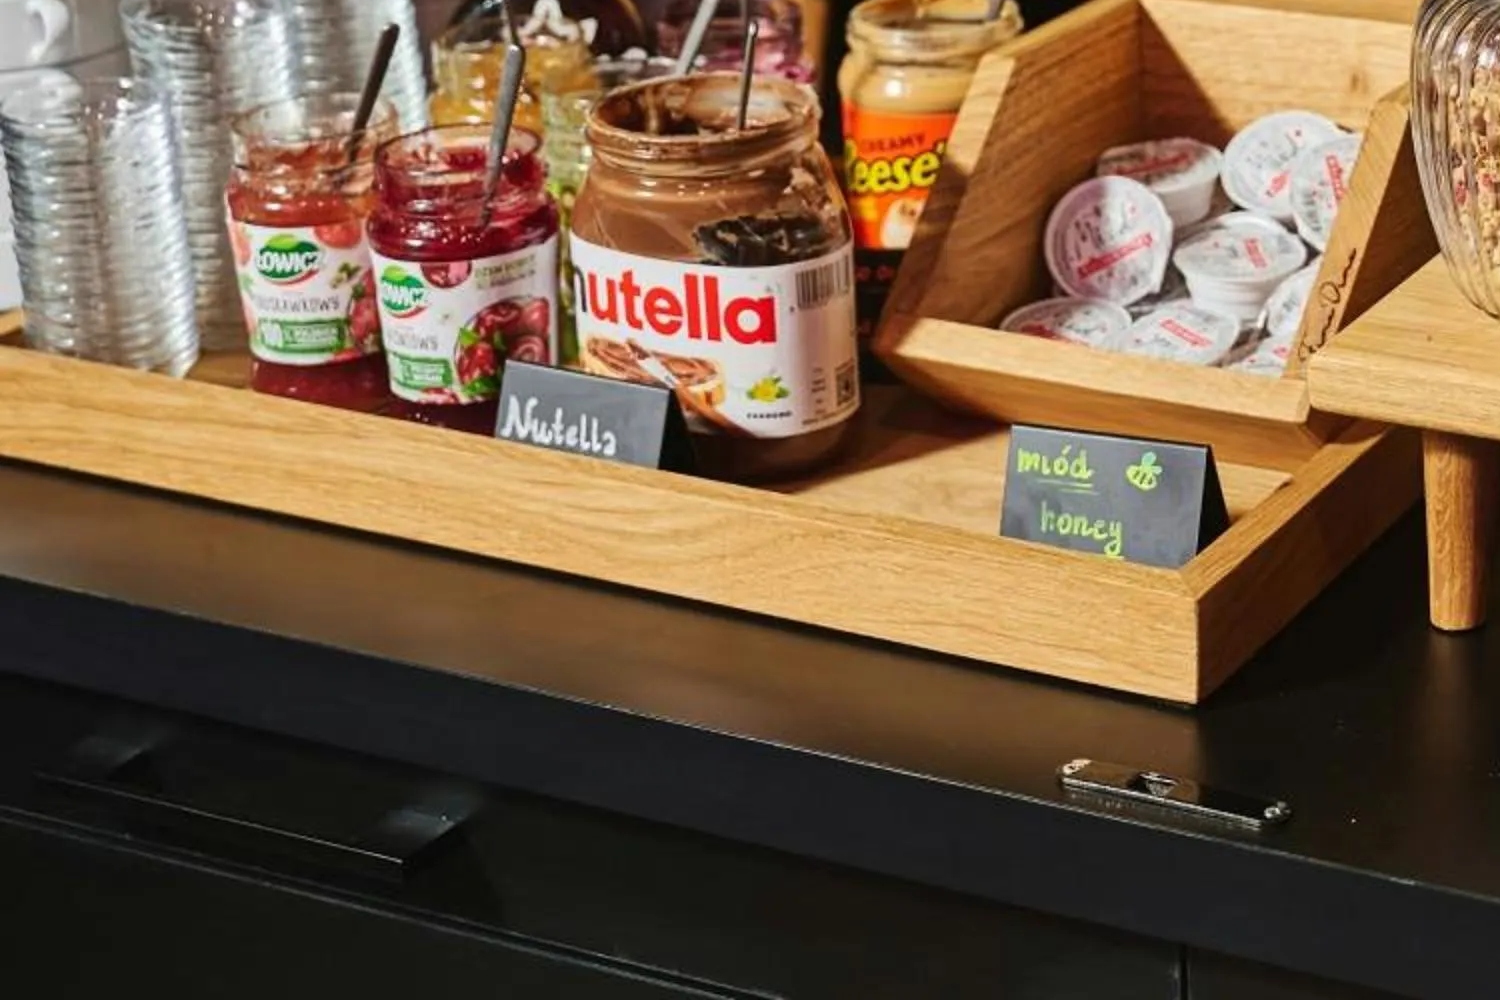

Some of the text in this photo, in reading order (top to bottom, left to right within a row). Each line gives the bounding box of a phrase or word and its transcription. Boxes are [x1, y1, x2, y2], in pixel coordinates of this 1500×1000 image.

[501, 394, 617, 456] Nutella
[1017, 445, 1094, 479] miód
[1040, 500, 1124, 559] honey
